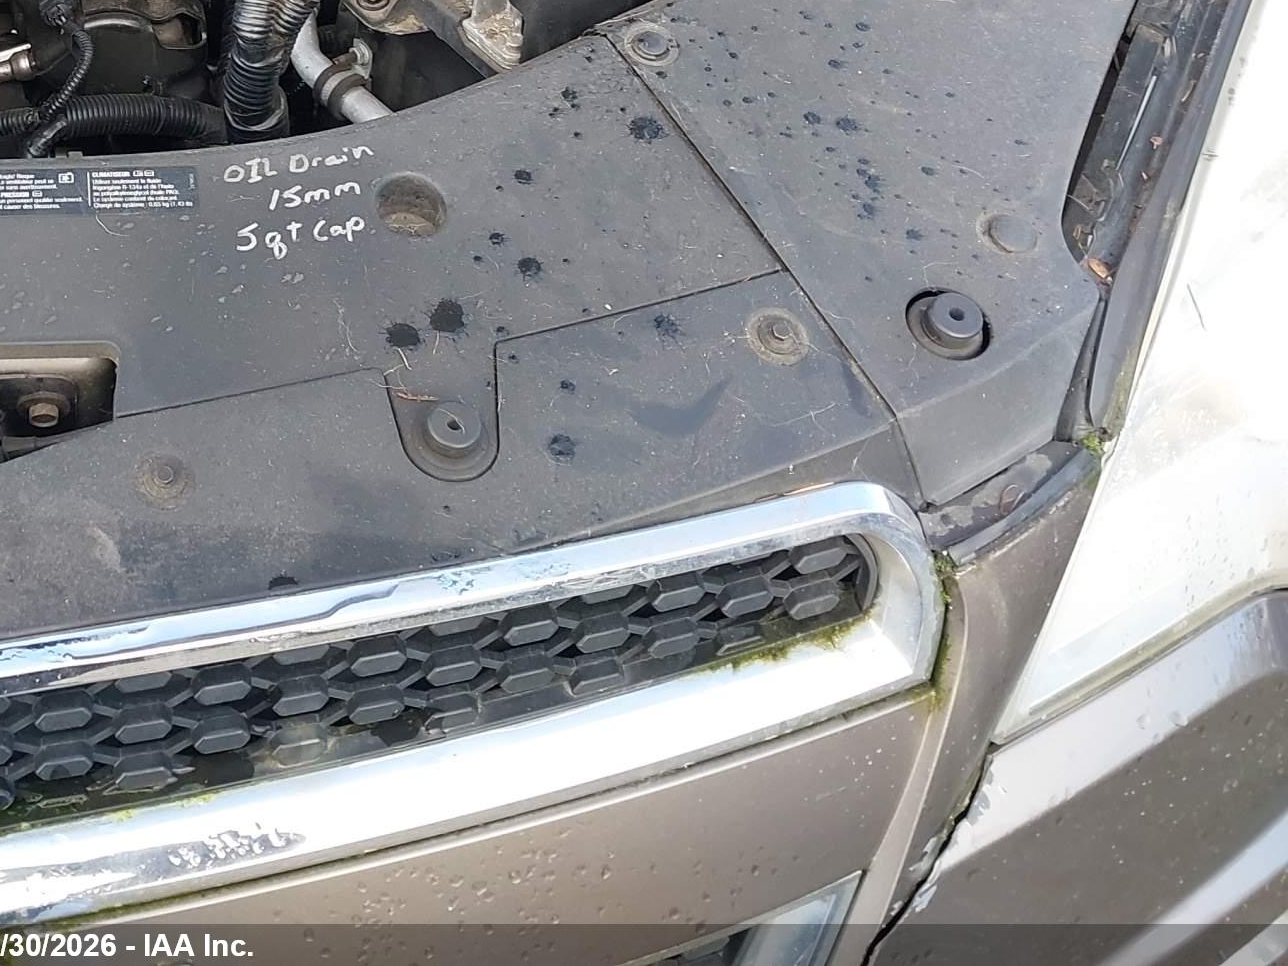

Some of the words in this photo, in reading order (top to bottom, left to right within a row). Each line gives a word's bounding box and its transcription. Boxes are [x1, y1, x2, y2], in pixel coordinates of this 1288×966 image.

[223, 158, 278, 183] OIL
[289, 146, 374, 173] Drain
[268, 182, 361, 210] 15mm
[313, 216, 365, 242] Cap
